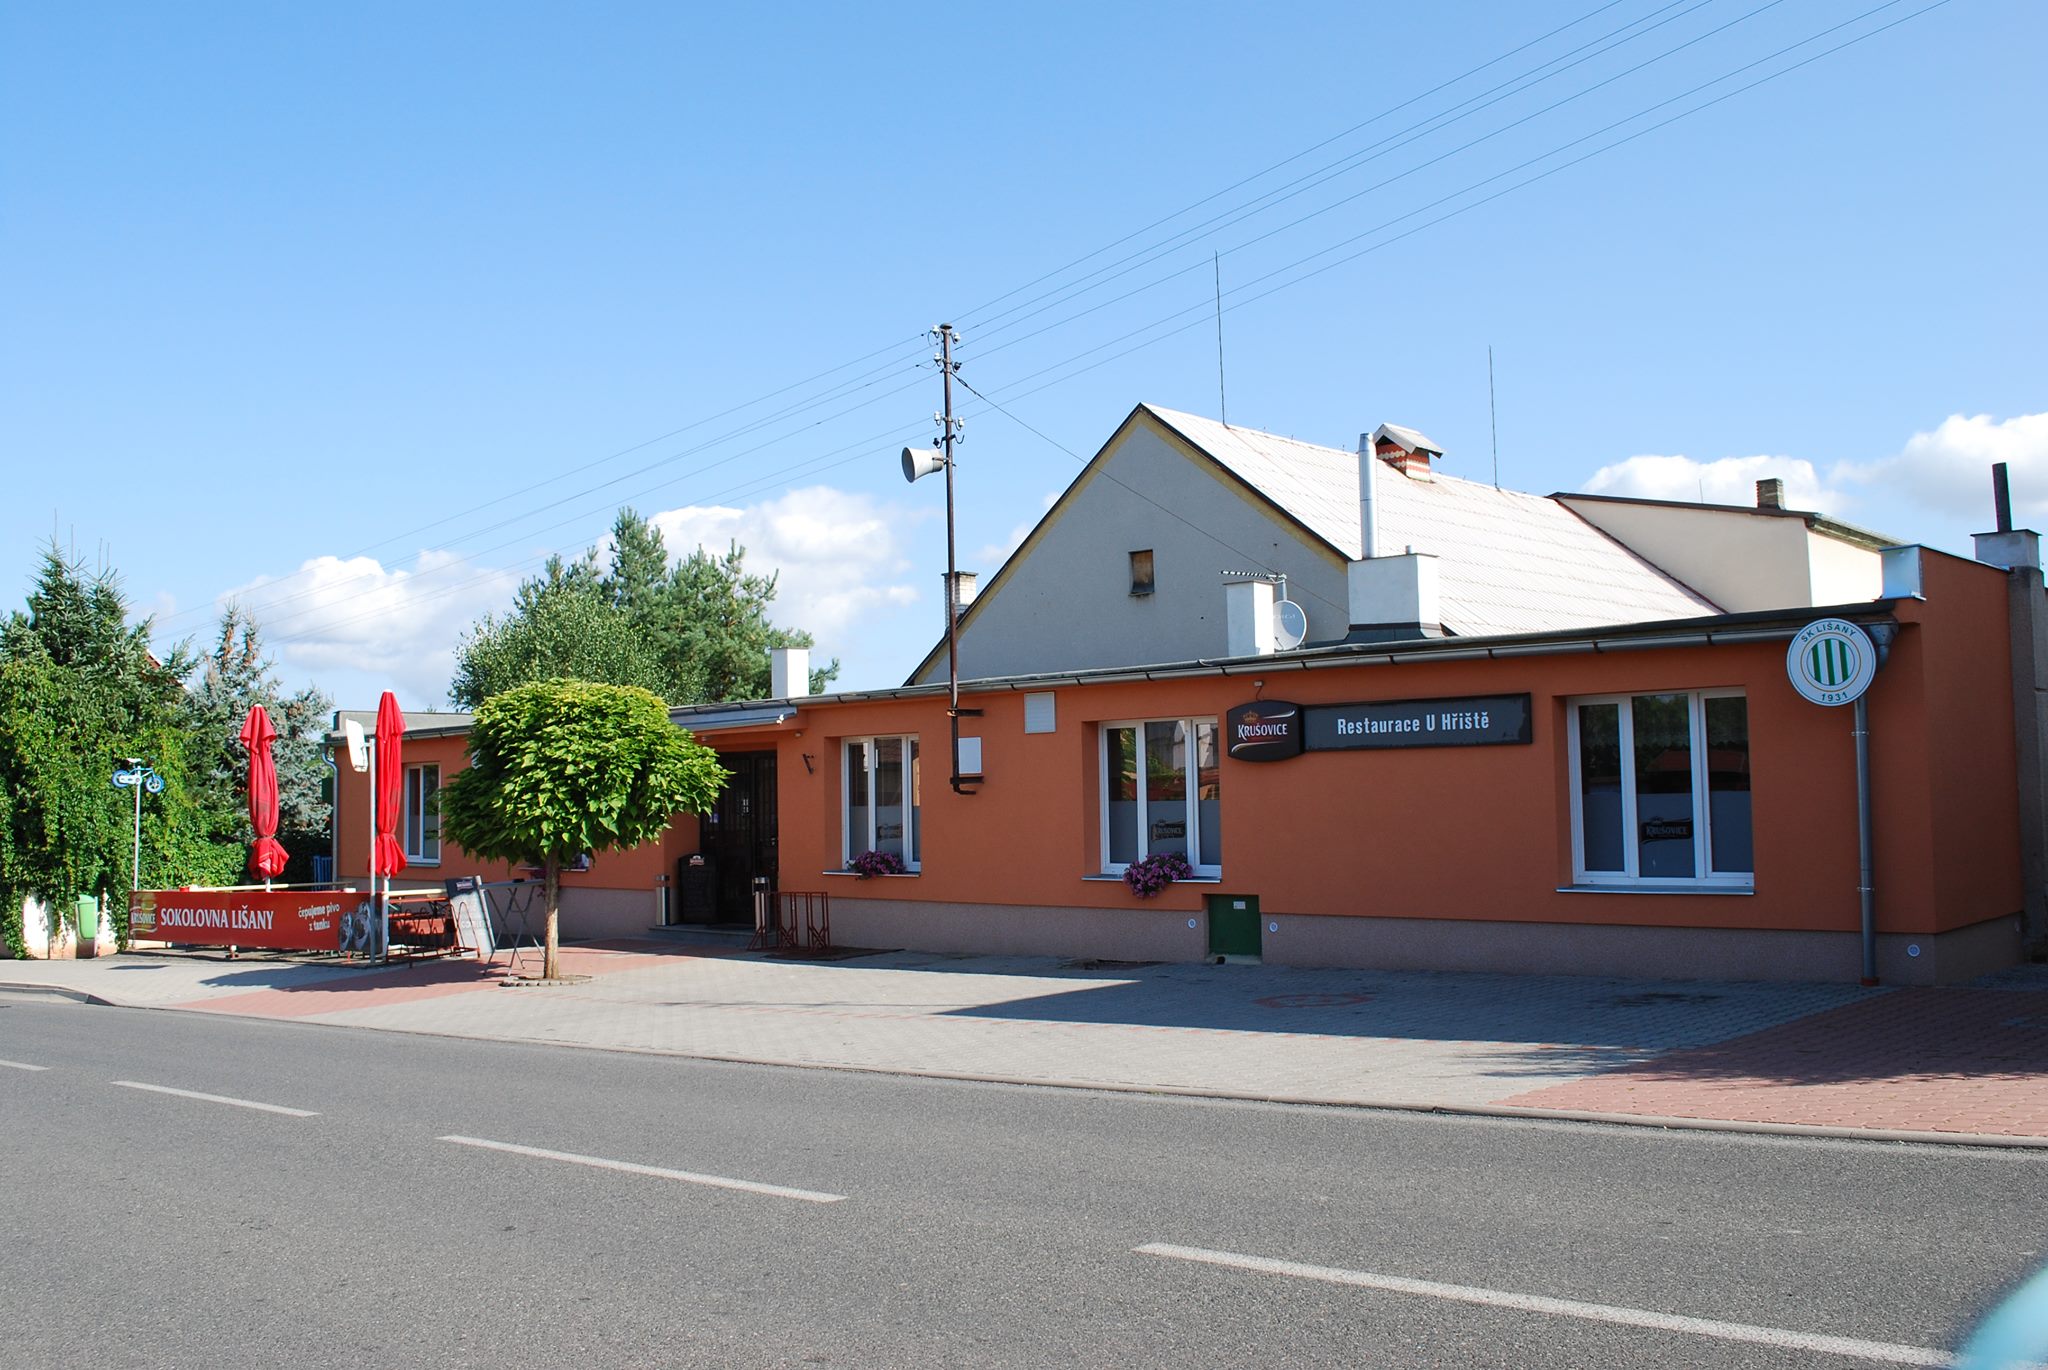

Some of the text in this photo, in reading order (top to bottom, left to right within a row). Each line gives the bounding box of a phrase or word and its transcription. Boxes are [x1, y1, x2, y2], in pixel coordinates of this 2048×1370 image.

[1801, 622, 1856, 642] SK LIŠANY
[1821, 692, 1848, 702] 1931
[1238, 722, 1288, 741] KRUŠOVICE
[1337, 711, 1490, 735] Restaurace U Hřiště
[160, 905, 274, 930] SOKOLOVNA LIŠANY
[326, 902, 340, 917] pivo
